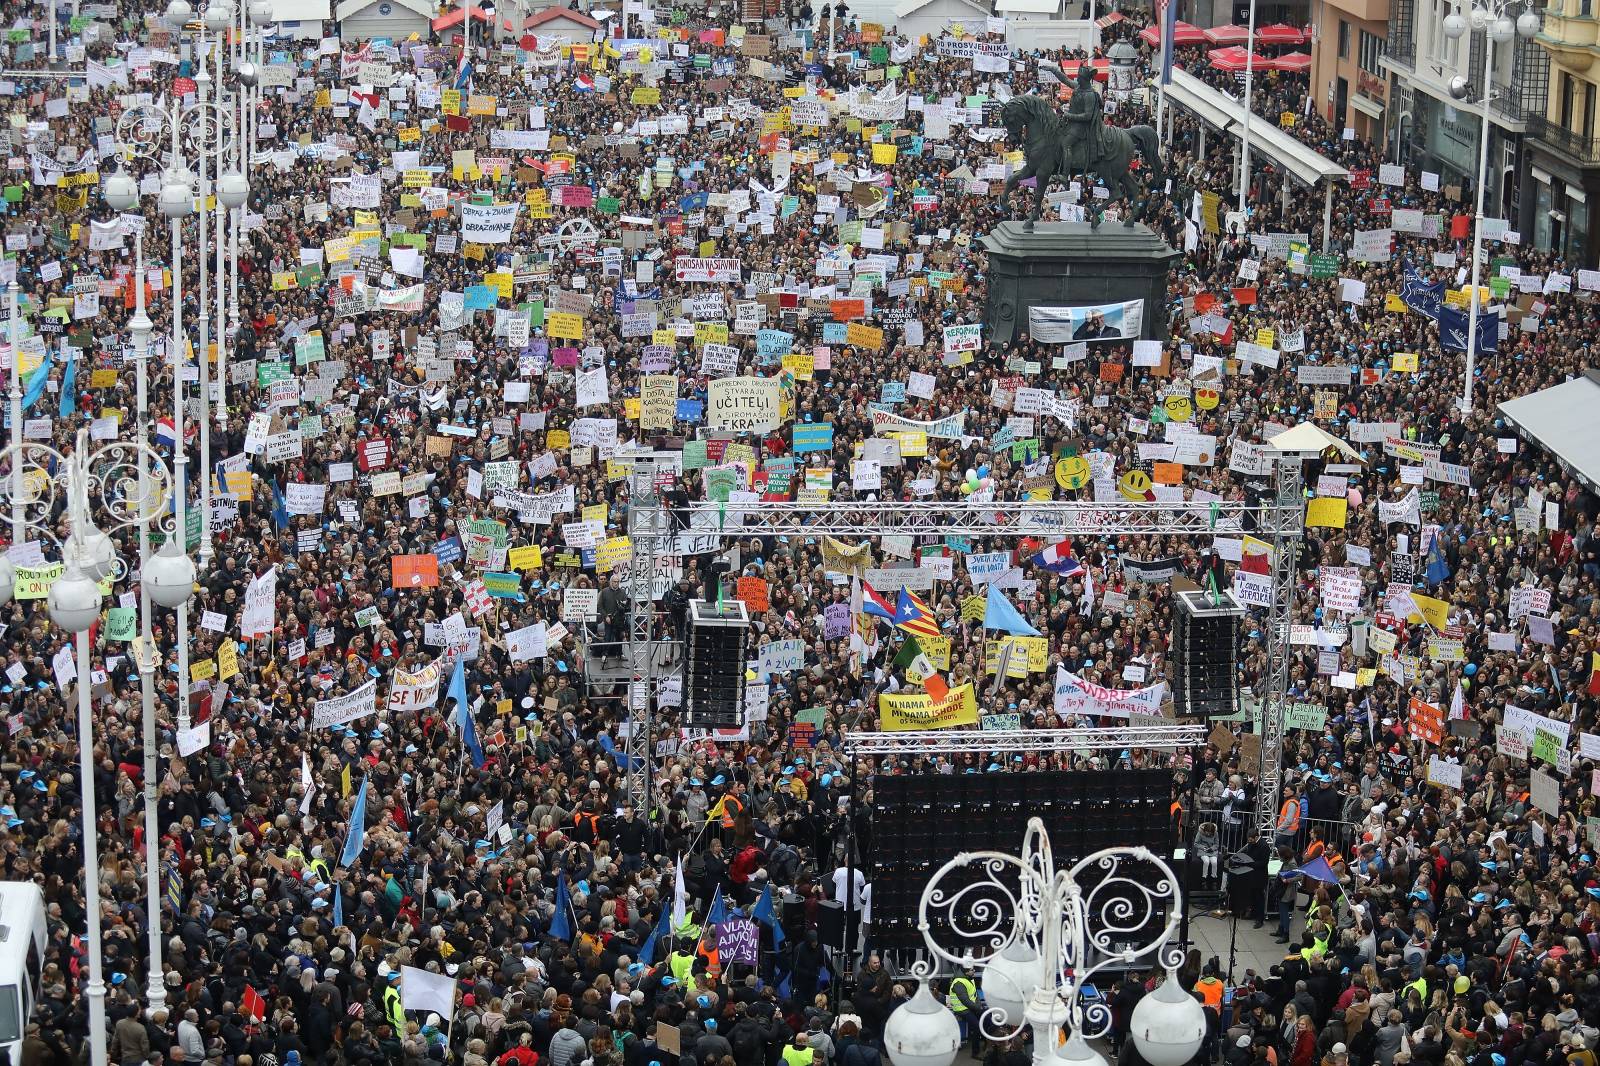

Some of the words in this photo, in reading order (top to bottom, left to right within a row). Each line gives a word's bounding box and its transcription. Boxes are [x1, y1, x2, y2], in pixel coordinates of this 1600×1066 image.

[466, 222, 512, 233] OBRAZOVANJE
[676, 258, 705, 270] PONOSAN
[705, 258, 739, 270] NASTAVNIK
[946, 326, 979, 338] REFORMA
[714, 381, 748, 389] NAPREDNO
[751, 380, 778, 388] DRUŠTVO
[725, 387, 765, 396] STVARAJU
[725, 411, 776, 420] SIROMAŠNO
[888, 700, 897, 709] VI
[899, 701, 925, 710] NAMA
[891, 709, 903, 718] MI
[903, 709, 930, 719] VAMA
[932, 702, 964, 718] ISHODE
[1505, 708, 1522, 718] SVE
[1523, 713, 1533, 723] ZA
[718, 931, 749, 947] AJMO
[748, 938, 758, 949] VI
[719, 947, 736, 960] NA
